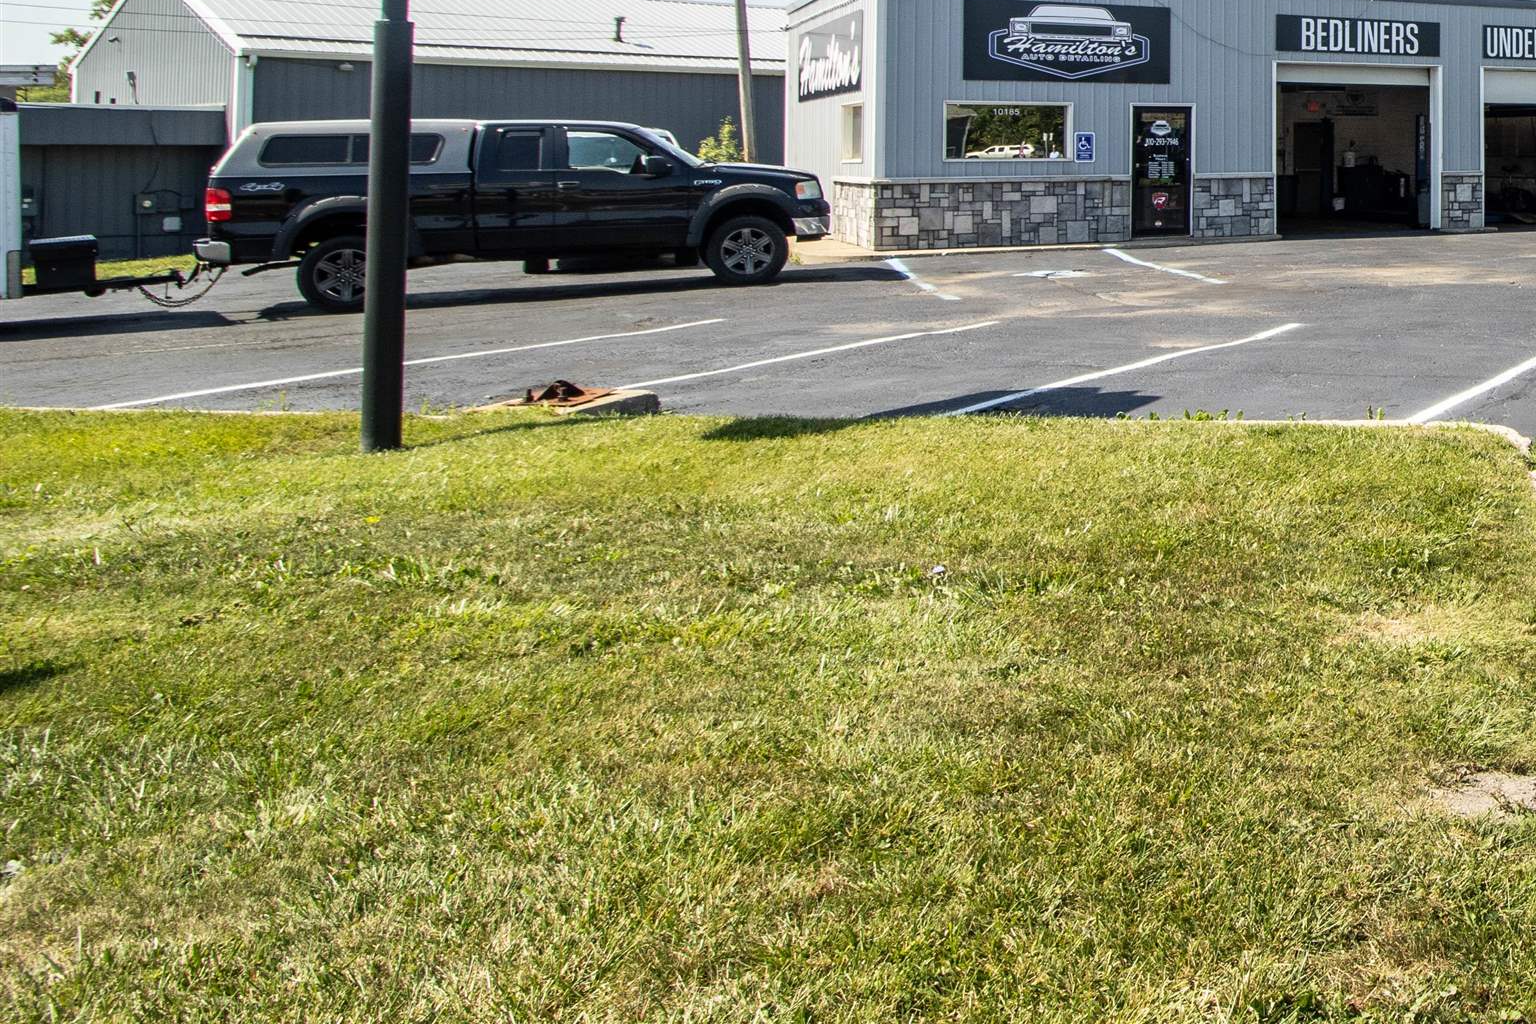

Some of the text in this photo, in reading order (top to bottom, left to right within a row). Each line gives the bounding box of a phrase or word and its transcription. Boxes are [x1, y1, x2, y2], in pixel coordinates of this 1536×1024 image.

[1003, 36, 1137, 56] Hamilton's
[1301, 17, 1419, 55] BEDLINERS
[1021, 53, 1121, 63] AUTO DETAILING
